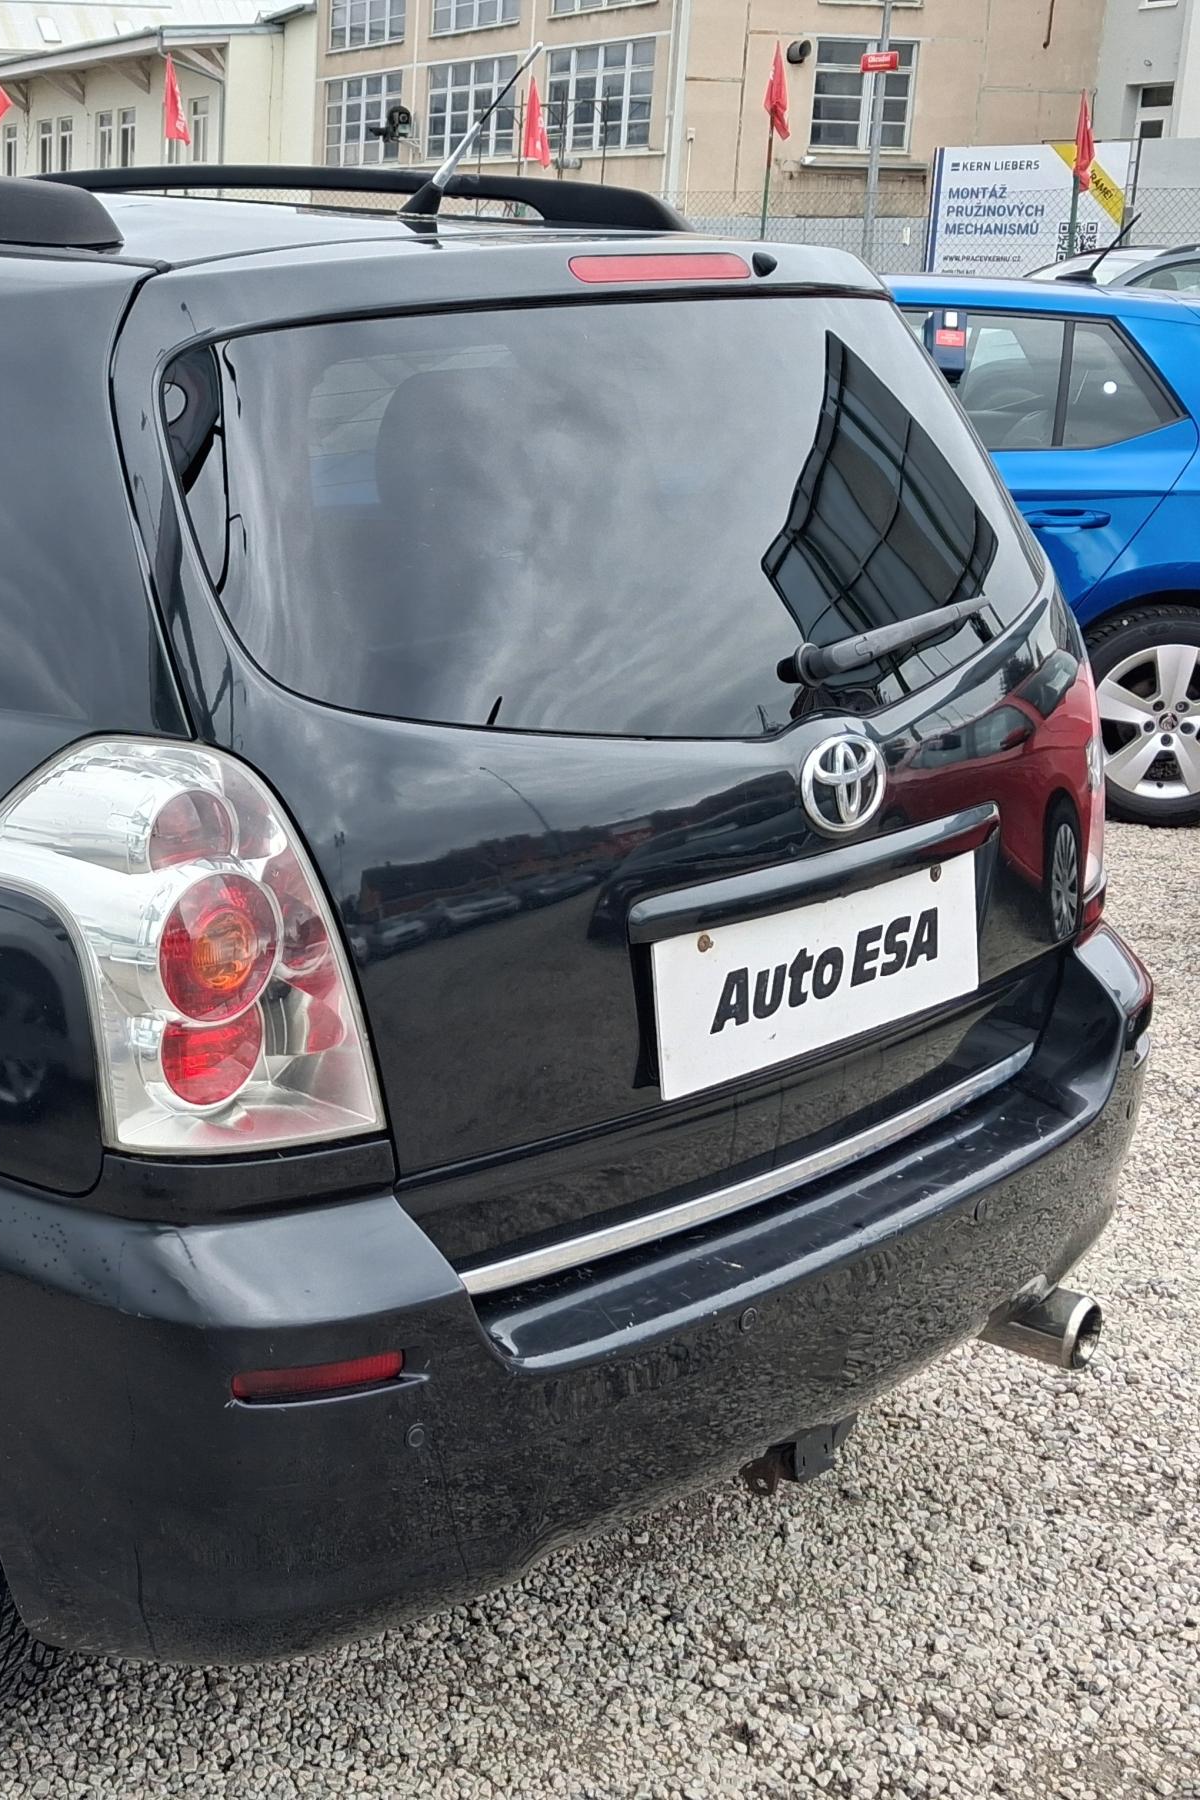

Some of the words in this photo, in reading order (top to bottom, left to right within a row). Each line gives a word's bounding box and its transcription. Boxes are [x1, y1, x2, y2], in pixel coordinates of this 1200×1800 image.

[962, 161, 991, 171] KERN
[994, 160, 1040, 171] LIEBERS
[949, 184, 1008, 199] MONTÁŽ
[946, 202, 1045, 217] PRUŽINOVÝCH
[944, 221, 1040, 235] MECHANISMŮ
[710, 947, 844, 1035] Auto
[850, 906, 938, 987] ESA
